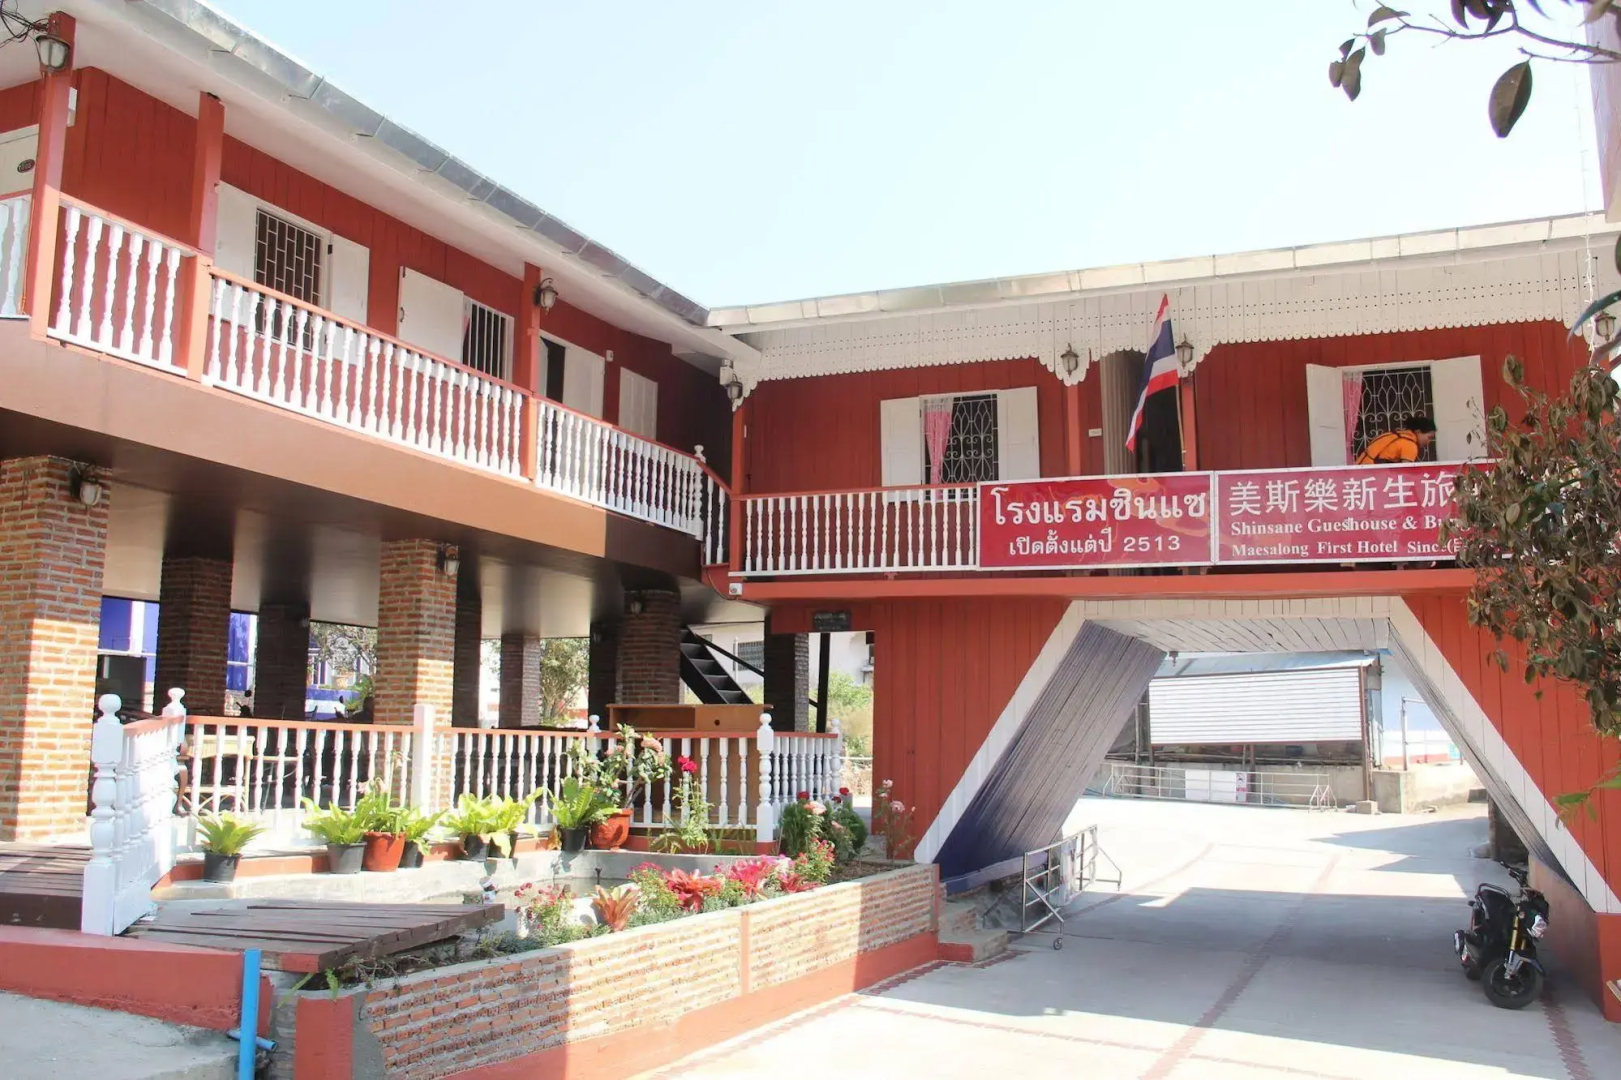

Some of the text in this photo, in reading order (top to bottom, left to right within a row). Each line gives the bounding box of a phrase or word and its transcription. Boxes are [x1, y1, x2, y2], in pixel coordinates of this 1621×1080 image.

[1229, 470, 1458, 516] 美斯樂新生旅
[1231, 521, 1303, 536] Shinsane
[1402, 516, 1418, 530] &
[1009, 527, 1181, 556] เปิดตั้งแต่ปี 2513
[1232, 543, 1309, 557] Maesalong
[1317, 541, 1352, 554] First
[1358, 540, 1397, 554] Hotel
